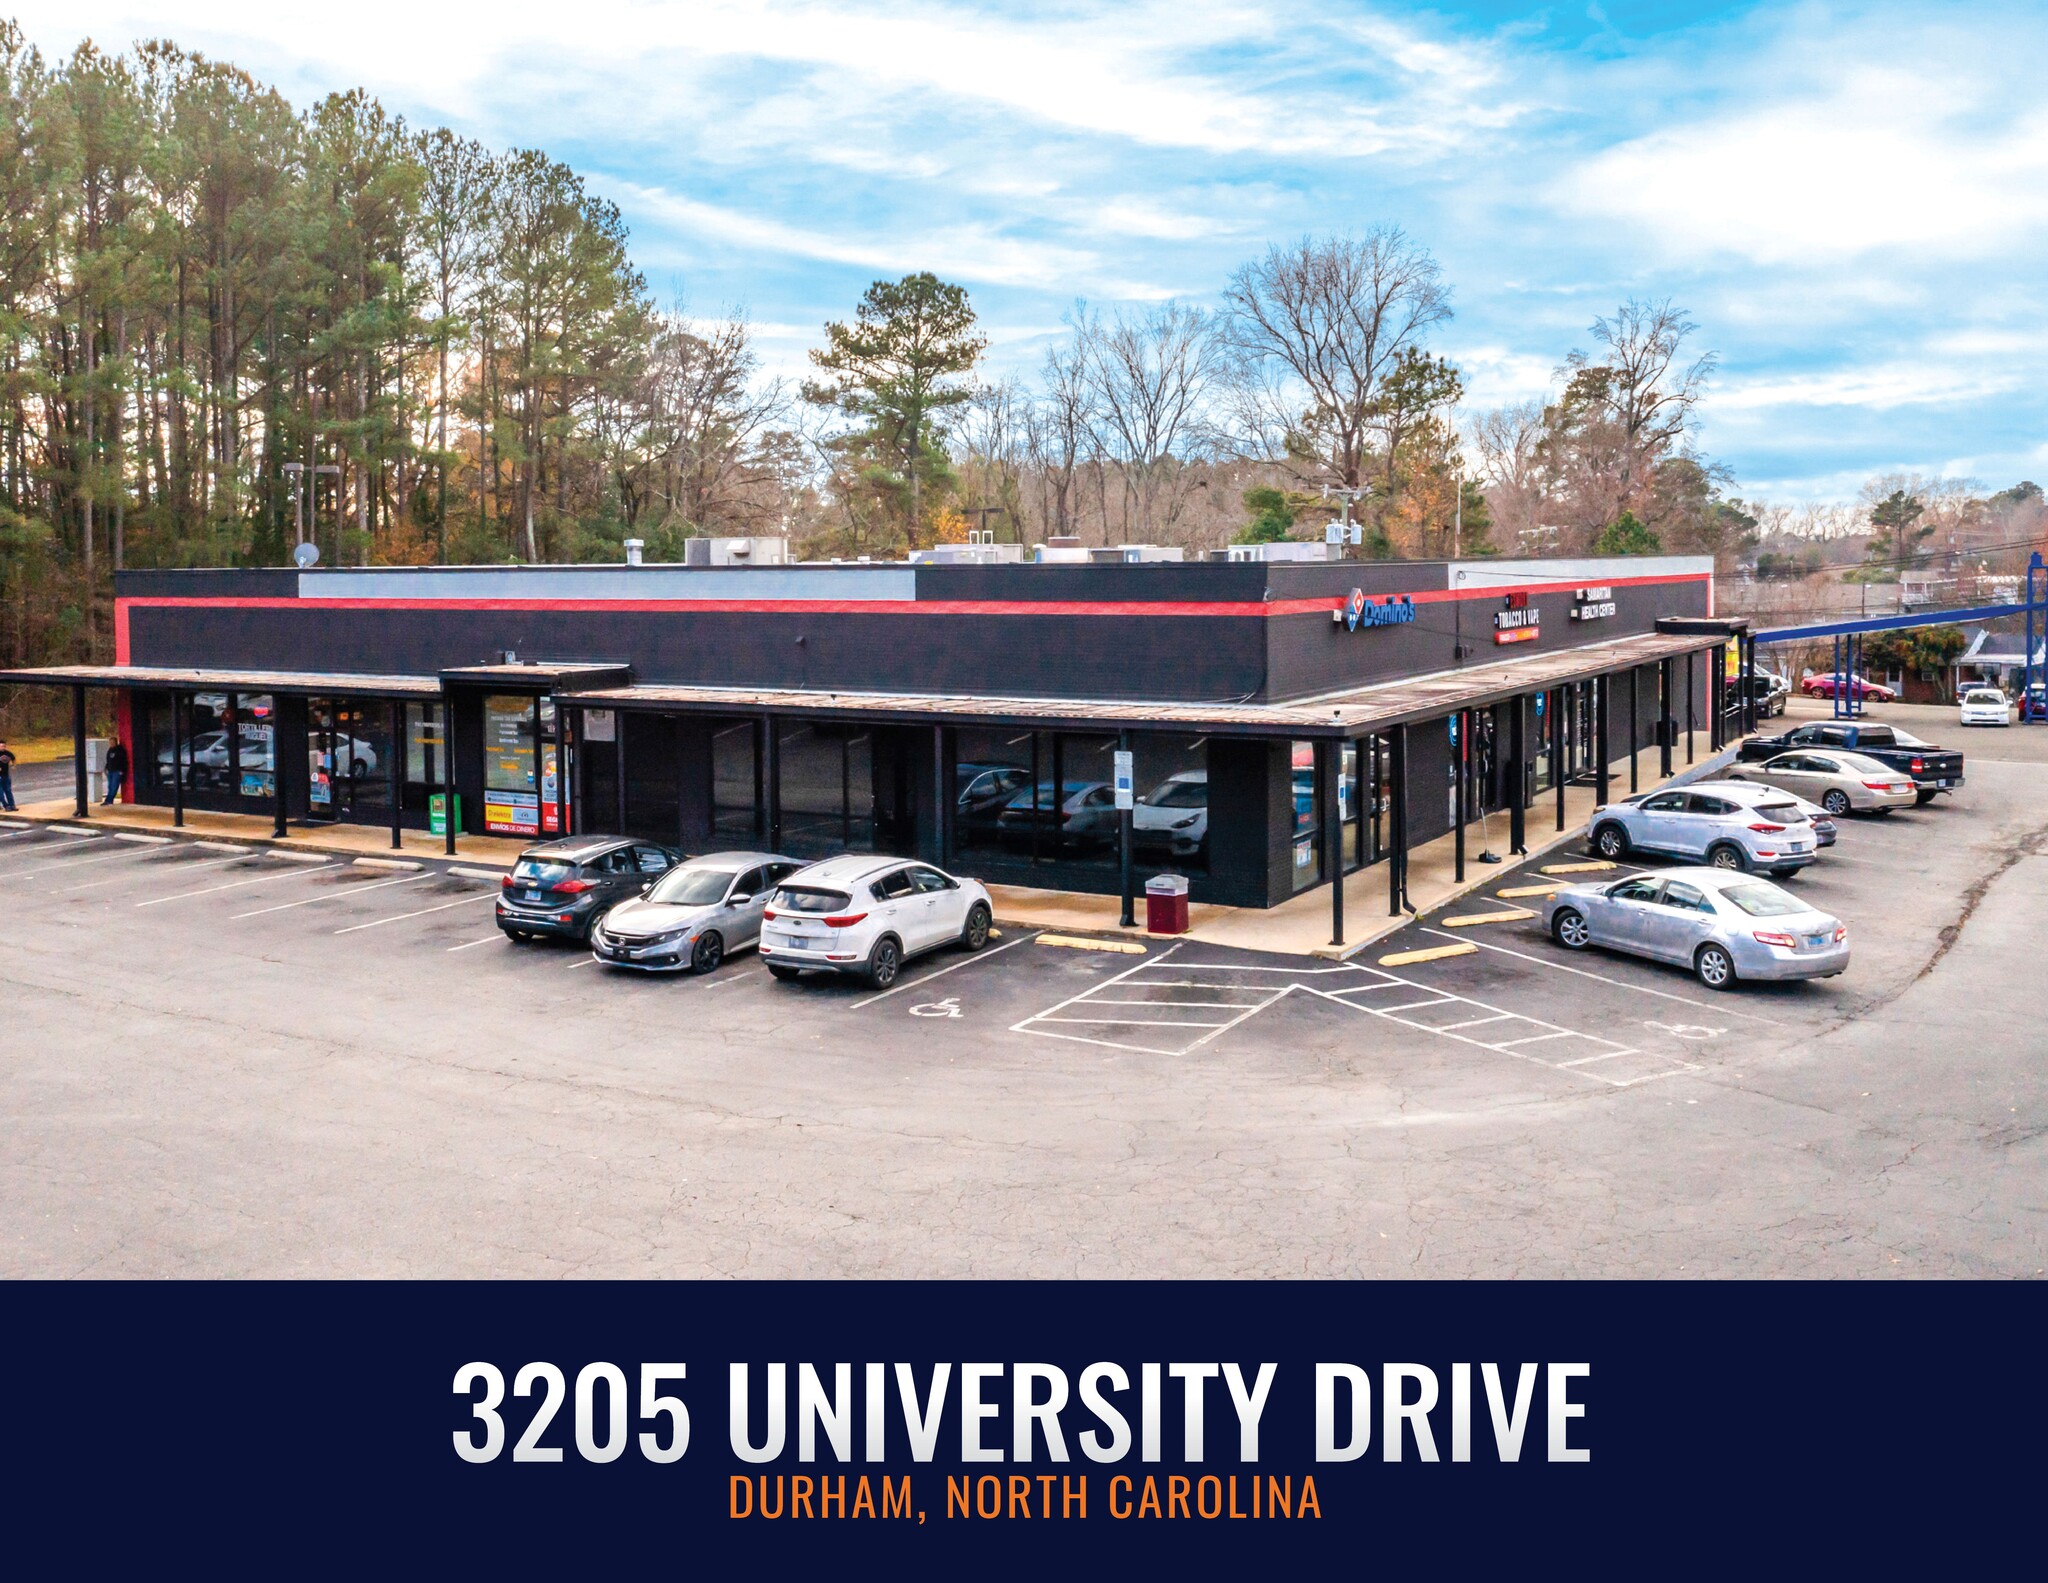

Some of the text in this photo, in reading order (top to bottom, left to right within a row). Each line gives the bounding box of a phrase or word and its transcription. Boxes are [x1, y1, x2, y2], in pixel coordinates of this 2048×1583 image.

[1363, 595, 1416, 627] Domino's
[1498, 610, 1522, 629] TOBACCO
[1527, 608, 1539, 624] VAPE
[1581, 602, 1616, 620] HEALTH CENTER
